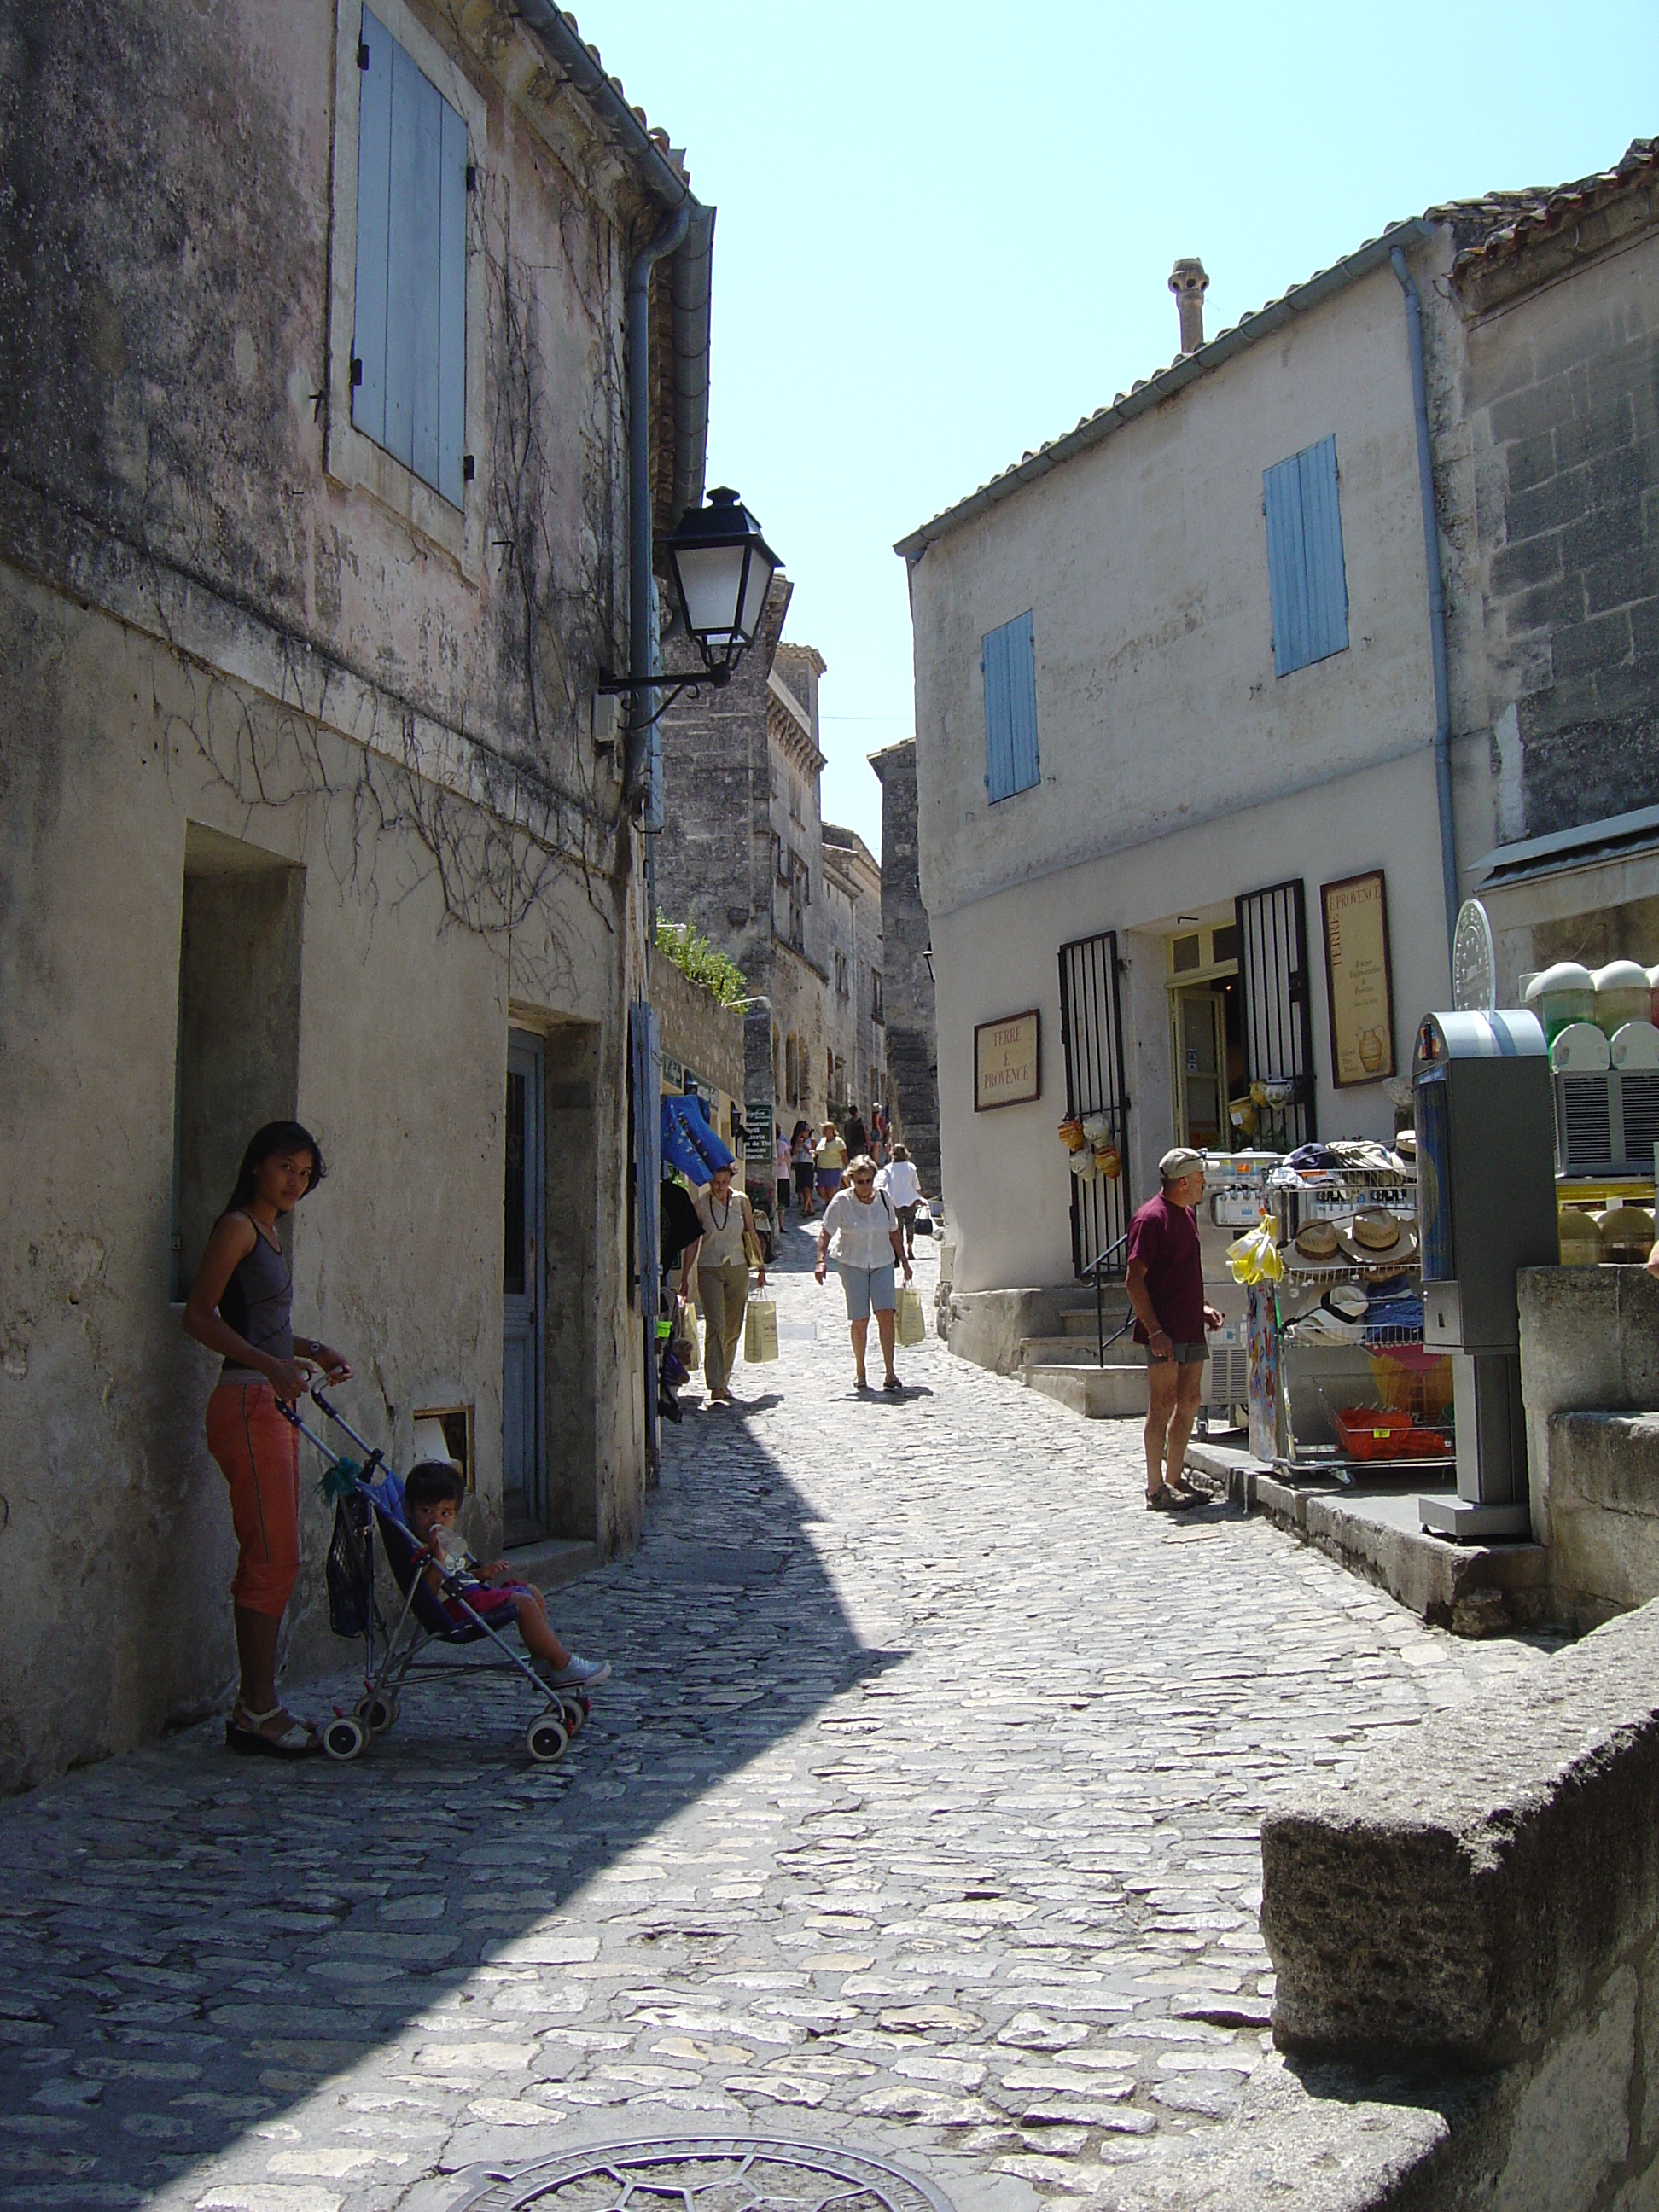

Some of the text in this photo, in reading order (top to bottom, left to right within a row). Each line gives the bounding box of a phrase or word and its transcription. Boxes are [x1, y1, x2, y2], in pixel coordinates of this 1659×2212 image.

[1336, 884, 1382, 910] PROVENCE
[1330, 914, 1342, 966] TERRE
[993, 1026, 1022, 1047] TERRE
[984, 1065, 1029, 1089] PROVENCE
